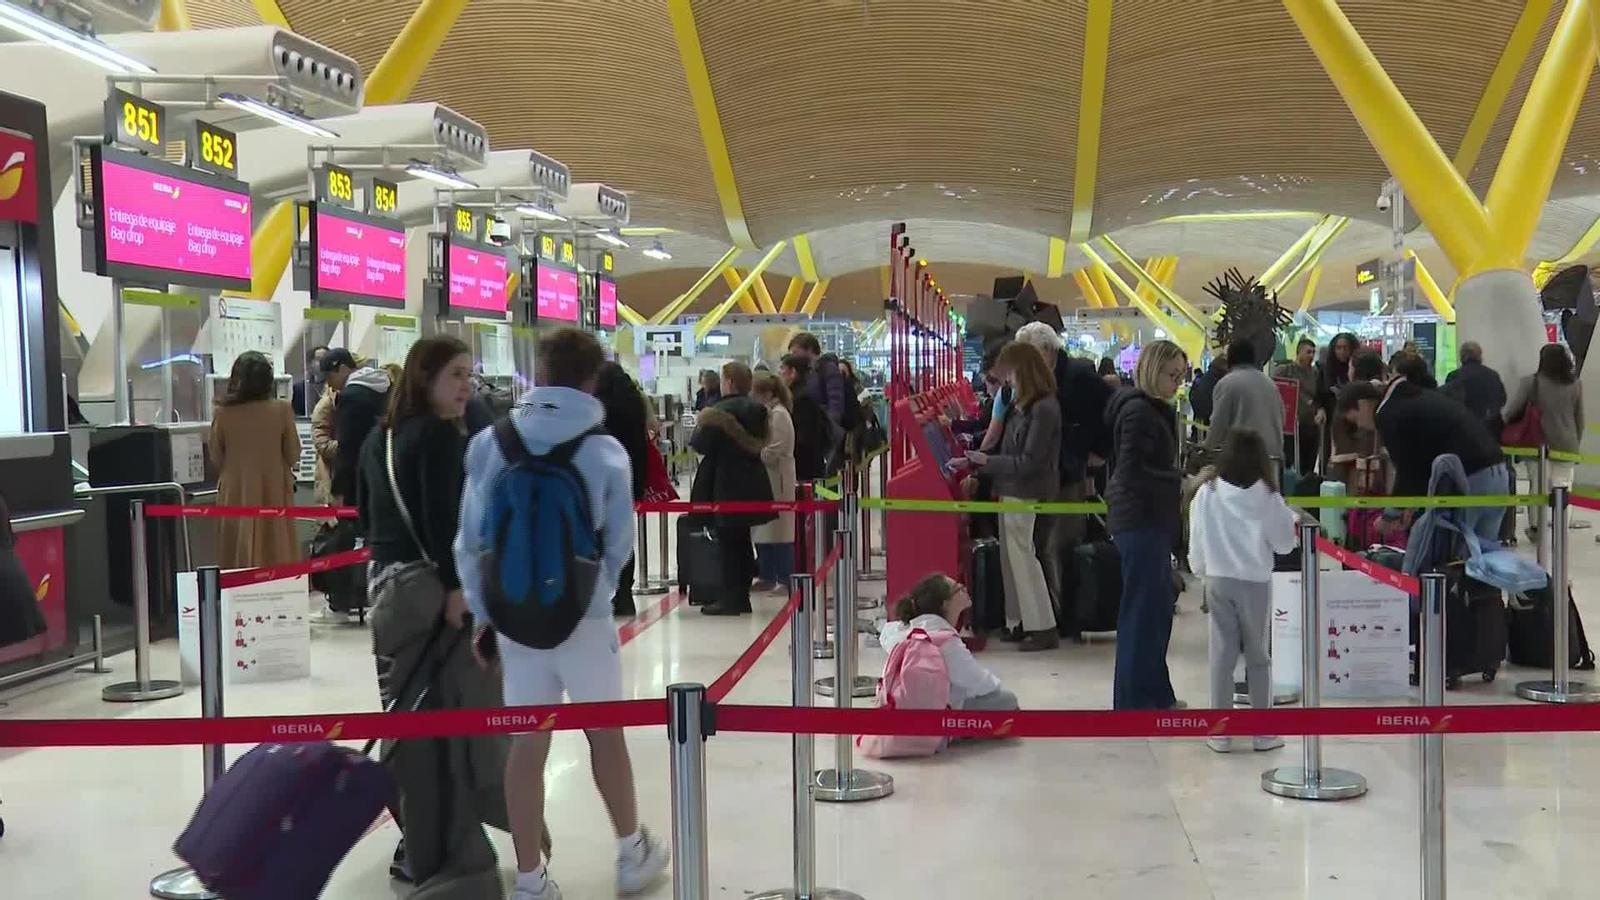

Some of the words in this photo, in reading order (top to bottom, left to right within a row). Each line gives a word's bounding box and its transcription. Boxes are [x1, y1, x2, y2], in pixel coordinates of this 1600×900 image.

[124, 102, 159, 145] 851
[202, 131, 234, 169] 852
[329, 170, 352, 200] 853
[375, 186, 396, 212] 854
[109, 207, 138, 229] Entrega
[139, 213, 148, 227] de
[149, 218, 176, 236] equipaje
[457, 209, 472, 233] 855
[111, 226, 125, 244] Bag
[126, 224, 144, 246] drop
[187, 223, 211, 241] Entrega
[212, 227, 220, 239] de
[221, 232, 244, 247] equipaje
[187, 239, 201, 256] Bag
[202, 238, 217, 258] drop
[272, 724, 324, 735] IBERIA
[487, 715, 538, 726] IBERIA
[942, 717, 993, 729] IBERIA
[1157, 717, 1208, 728] IBERIA
[1377, 715, 1431, 726] IBERIA
